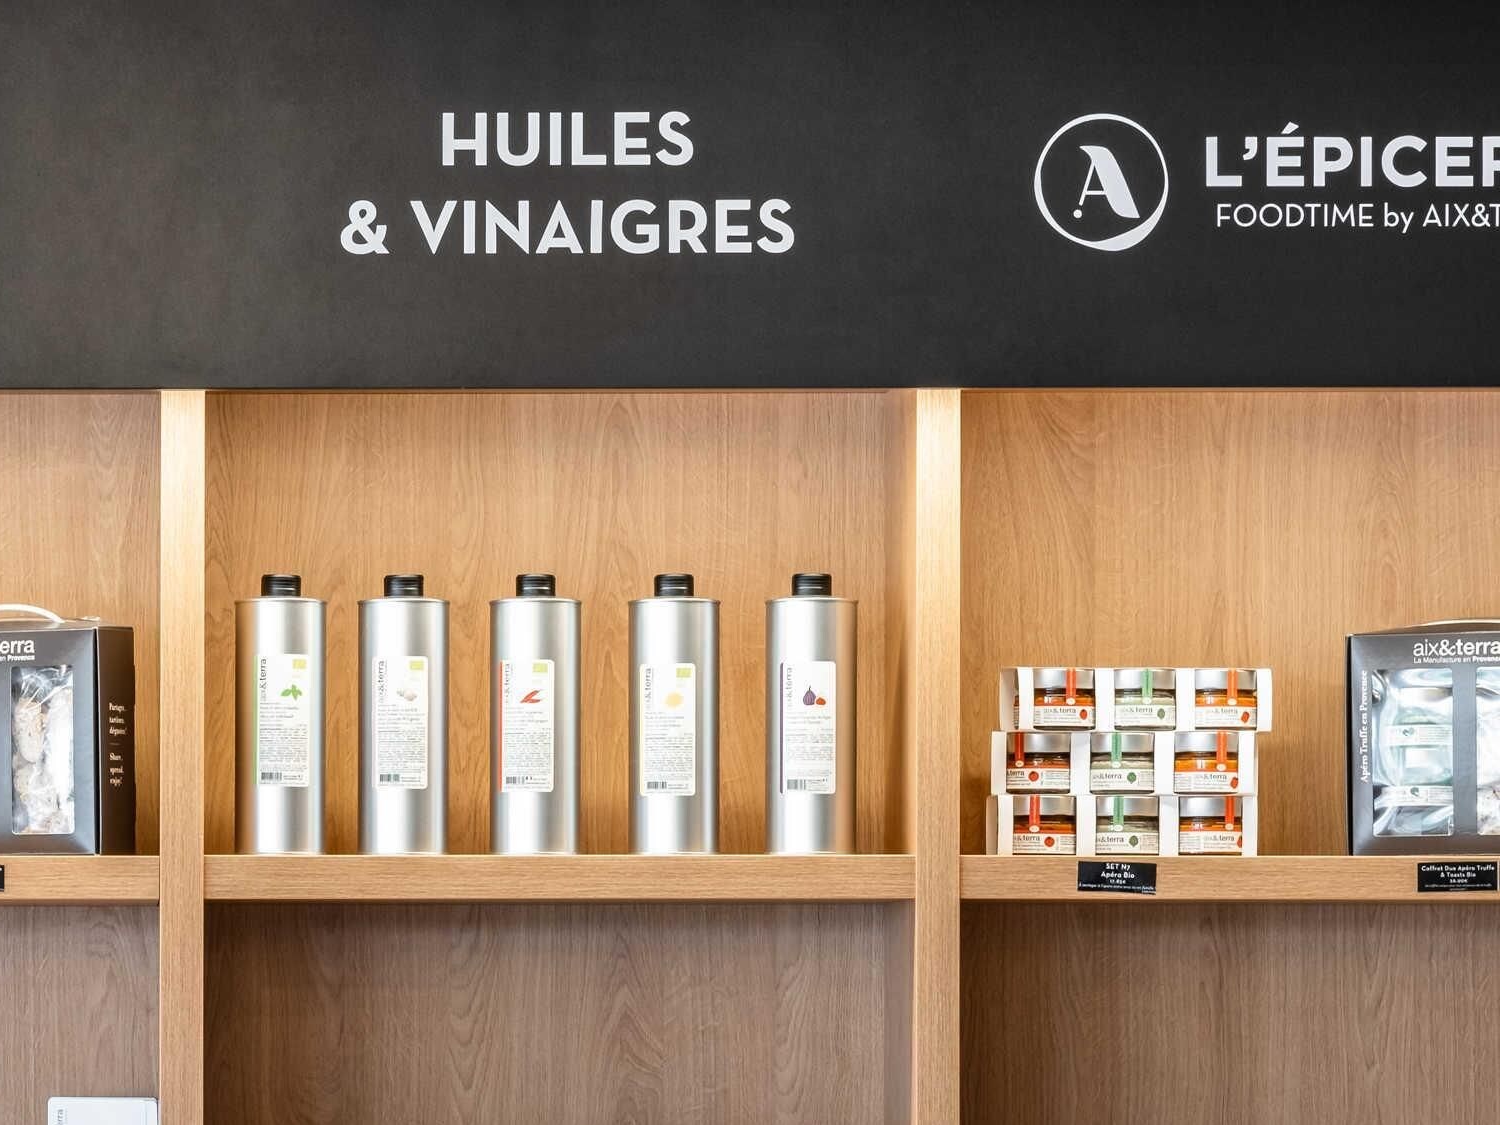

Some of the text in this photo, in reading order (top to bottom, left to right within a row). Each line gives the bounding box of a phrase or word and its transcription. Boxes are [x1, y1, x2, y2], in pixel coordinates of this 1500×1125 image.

[442, 110, 694, 167] HUILES
[340, 198, 795, 255] & VINAIGRES
[1216, 203, 1374, 228] FOODTIME
[1383, 201, 1415, 234] by
[1413, 639, 1500, 656] aix&terra
[1101, 871, 1122, 879] Apéro
